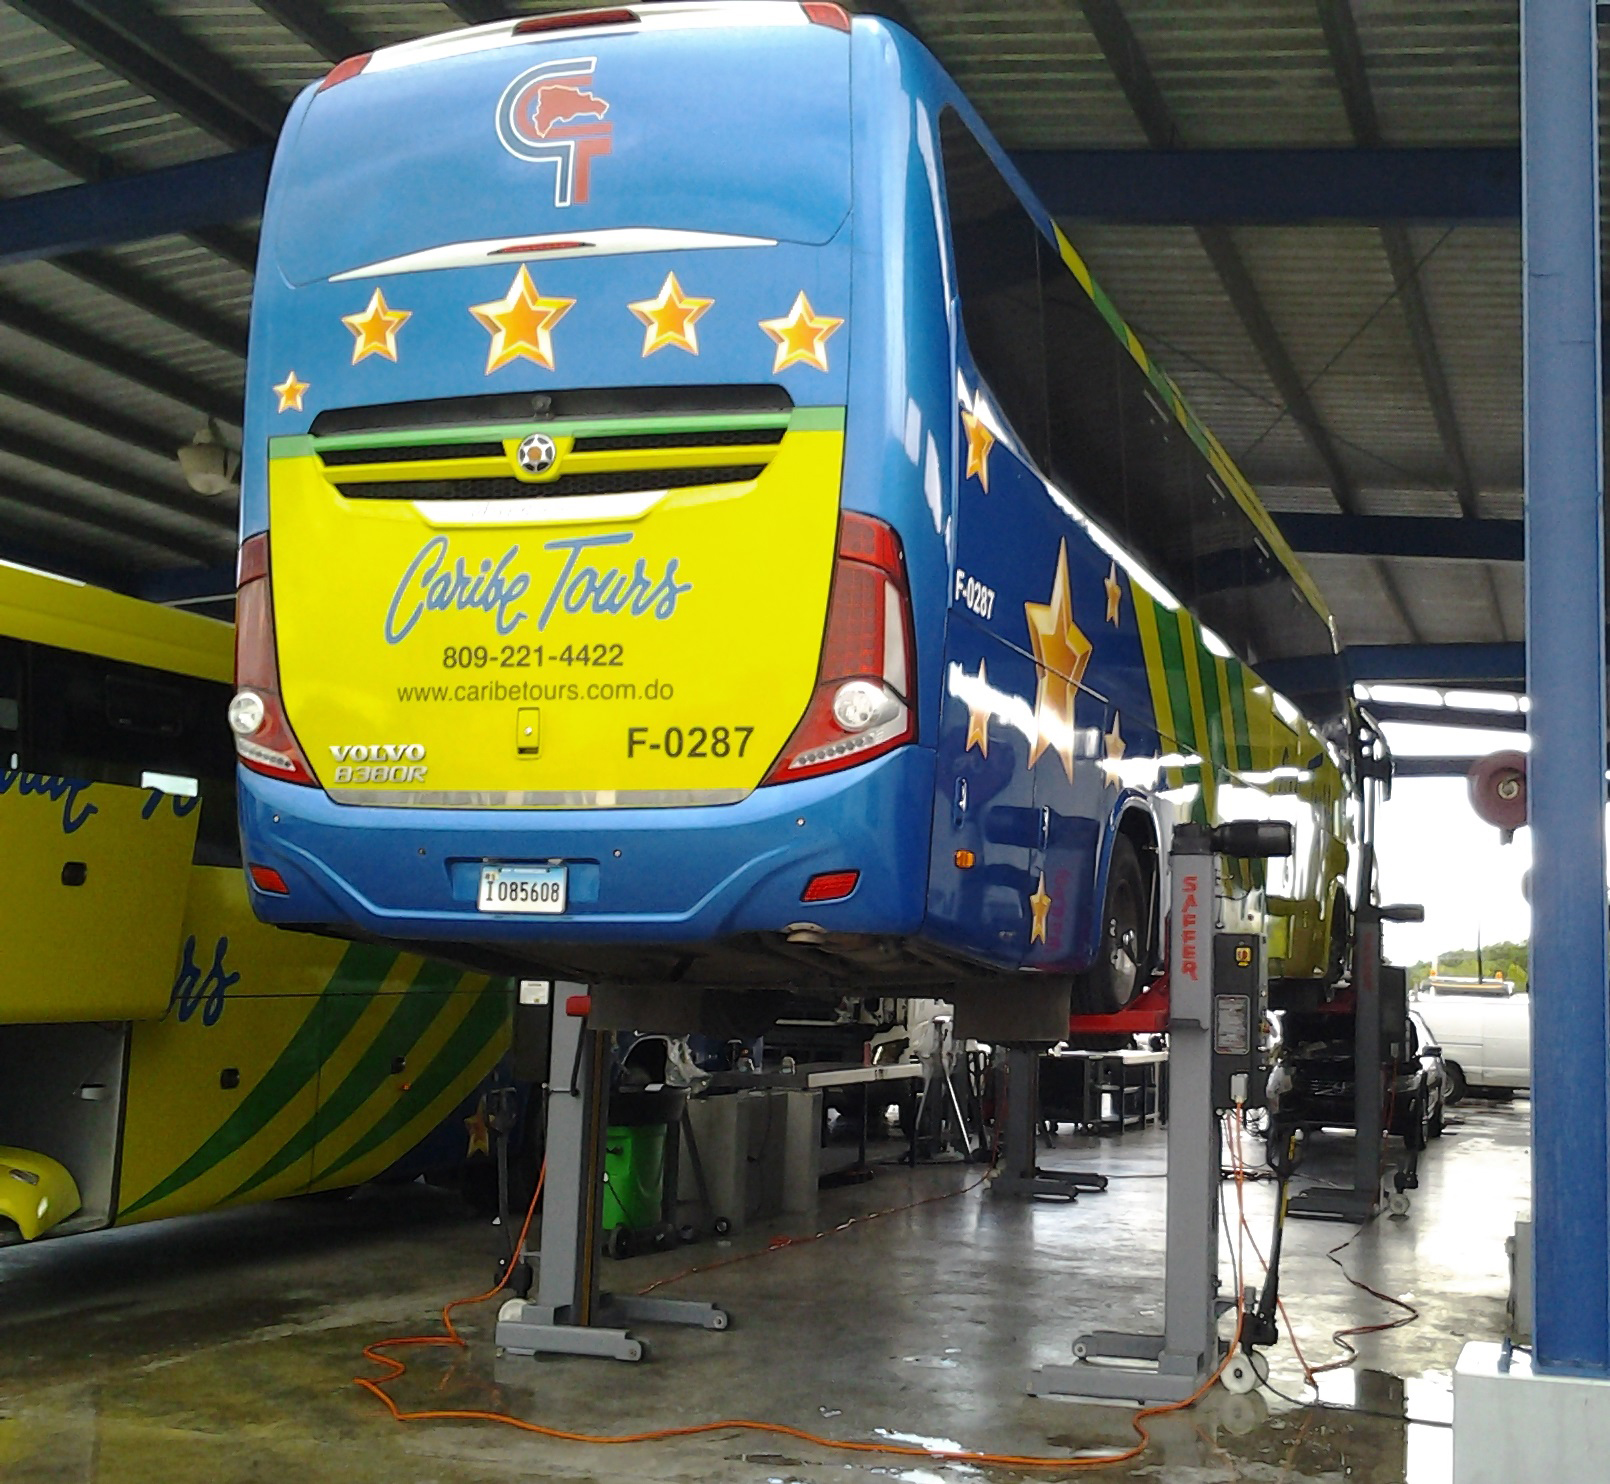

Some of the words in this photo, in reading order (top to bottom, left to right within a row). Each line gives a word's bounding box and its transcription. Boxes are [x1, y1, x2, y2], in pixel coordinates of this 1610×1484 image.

[384, 535, 531, 645] Caribe
[537, 531, 693, 631] Tours
[955, 568, 996, 621] F-0287
[442, 643, 625, 669] 809-221-4422
[396, 679, 675, 703] www.caribetours.com.do
[328, 744, 427, 763] VOLVO
[627, 726, 755, 759] F-0287
